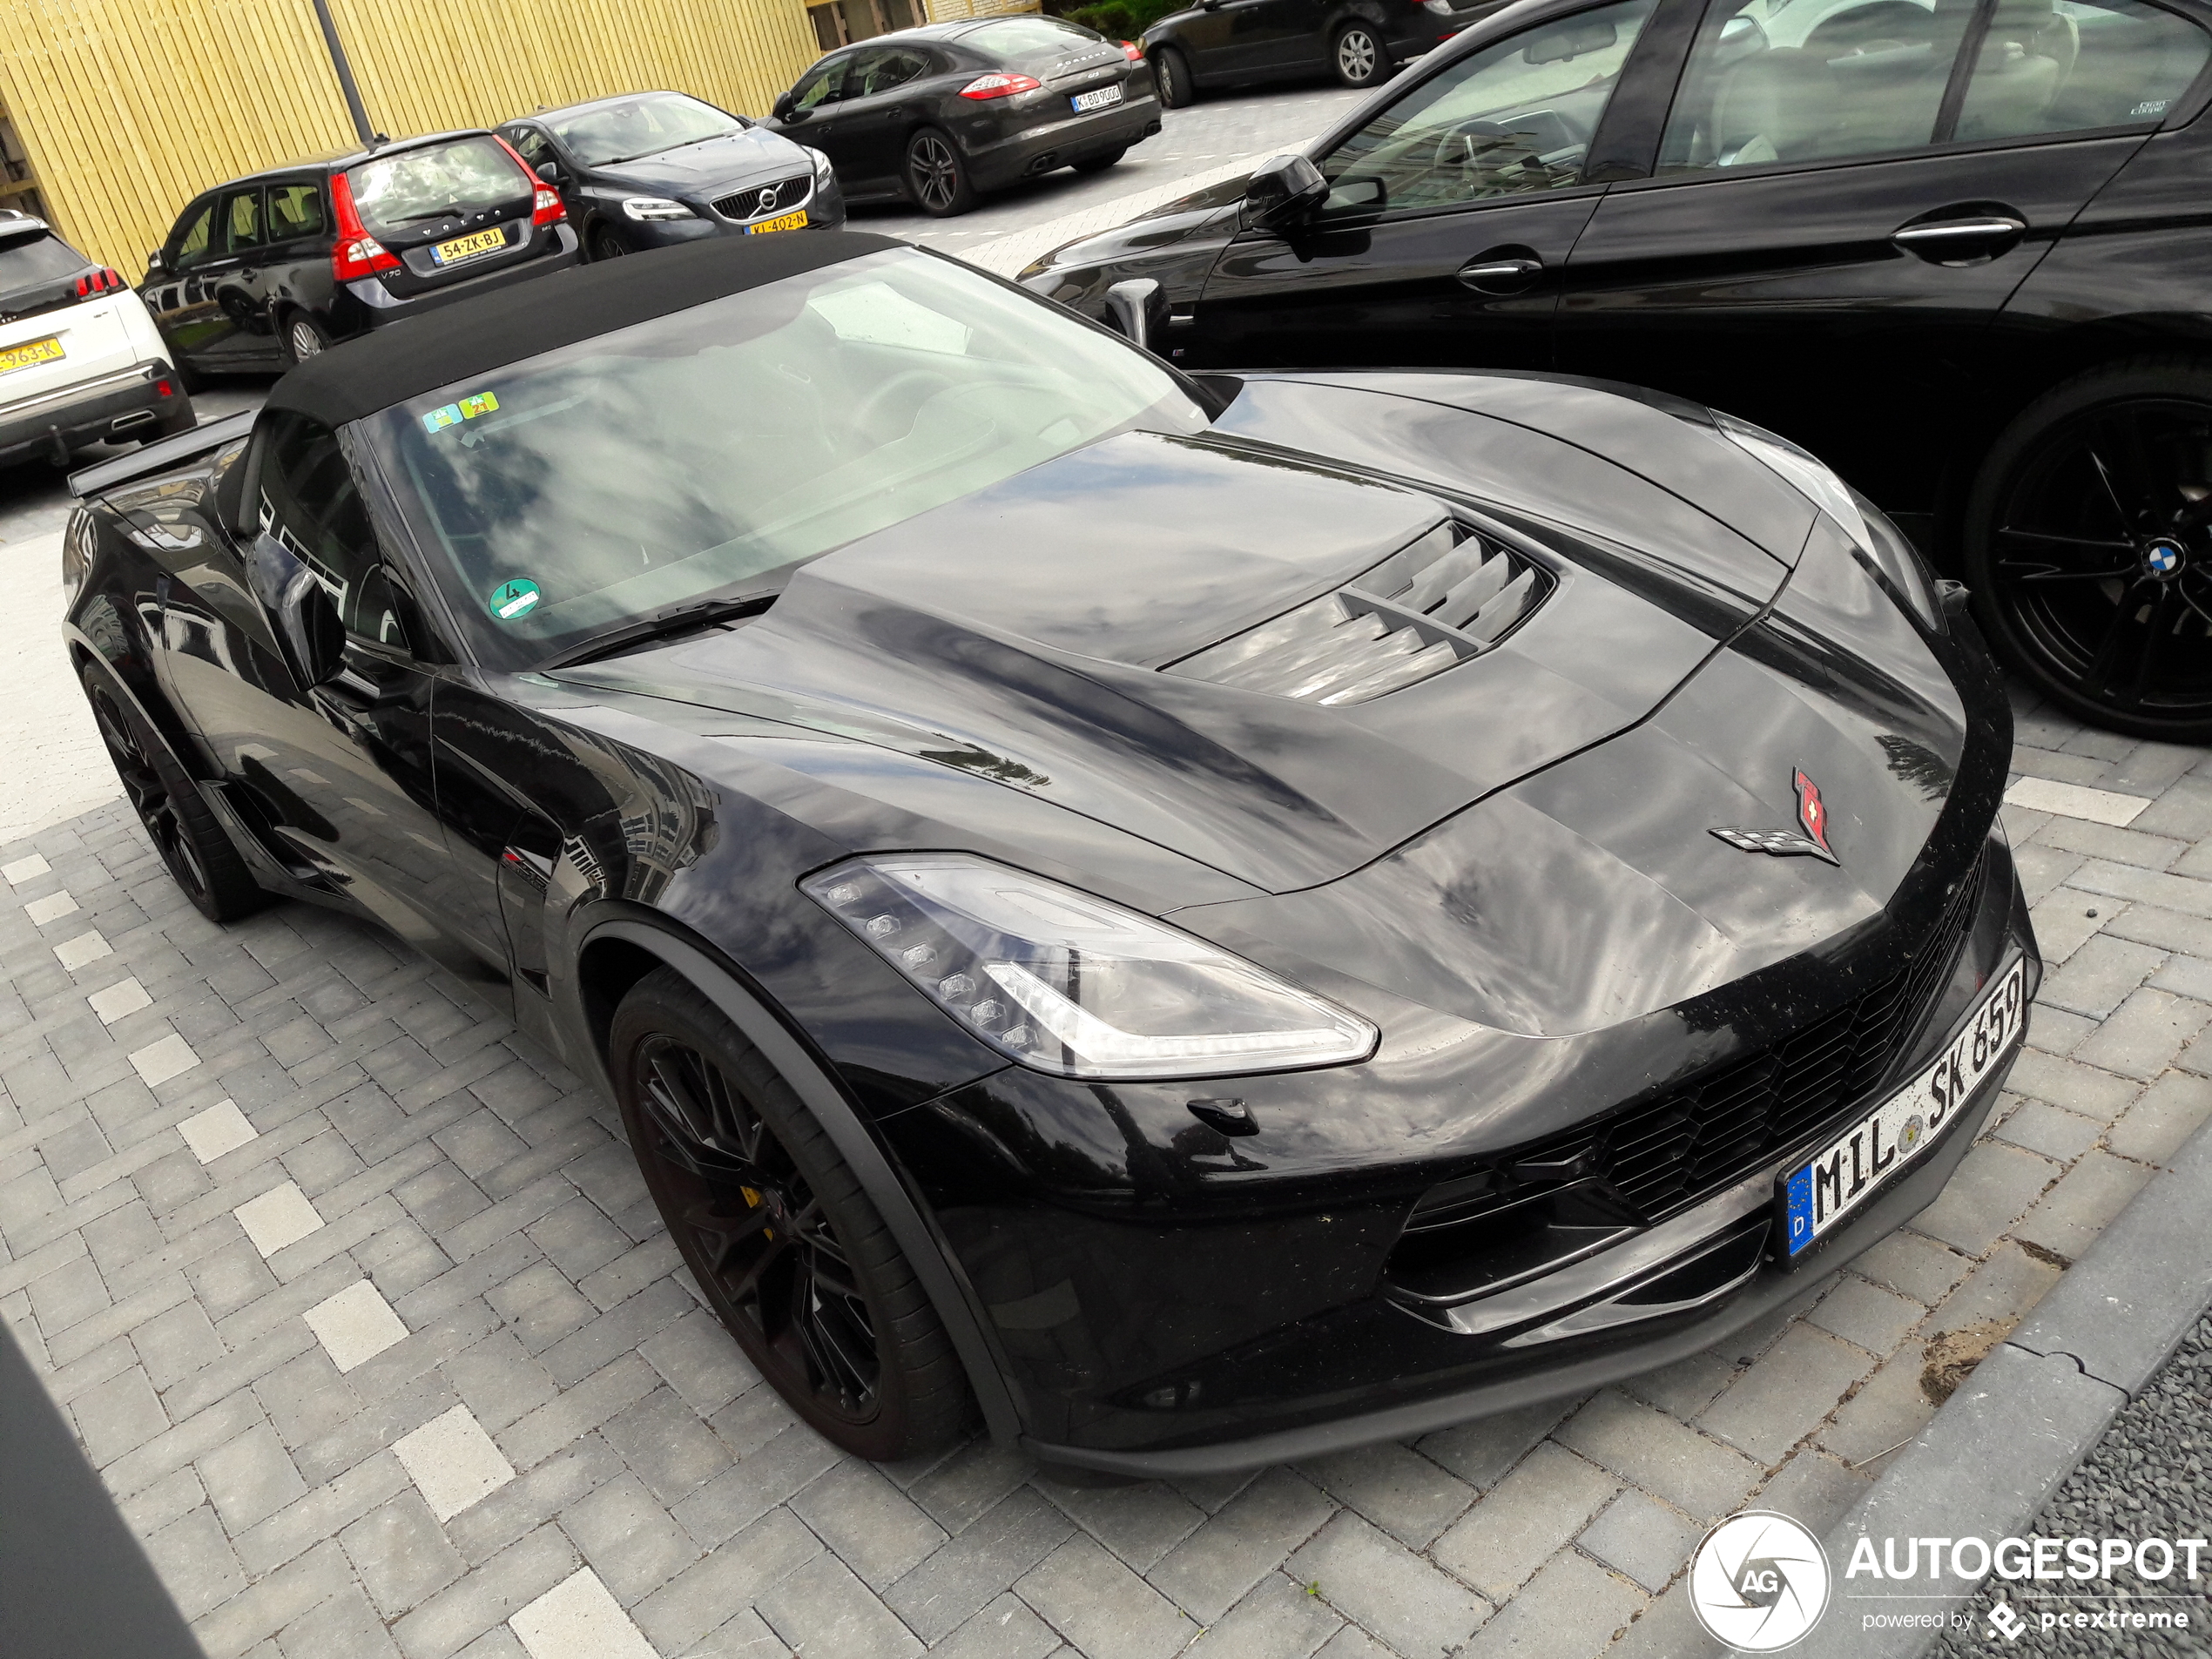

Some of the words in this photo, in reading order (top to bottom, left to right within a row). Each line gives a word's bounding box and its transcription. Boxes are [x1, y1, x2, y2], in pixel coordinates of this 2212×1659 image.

[1077, 97, 1084, 108] K
[1088, 93, 1100, 105] BD
[1100, 87, 1120, 102] 9000
[443, 231, 499, 258] 54-ZK-BJ
[381, 268, 401, 280] V70
[472, 402, 489, 414] 21
[506, 583, 521, 600] 4
[1794, 1216, 1804, 1237] D
[1816, 1116, 1895, 1225] MIL
[1929, 1035, 1966, 1129] SK
[1973, 970, 2020, 1073] 659
